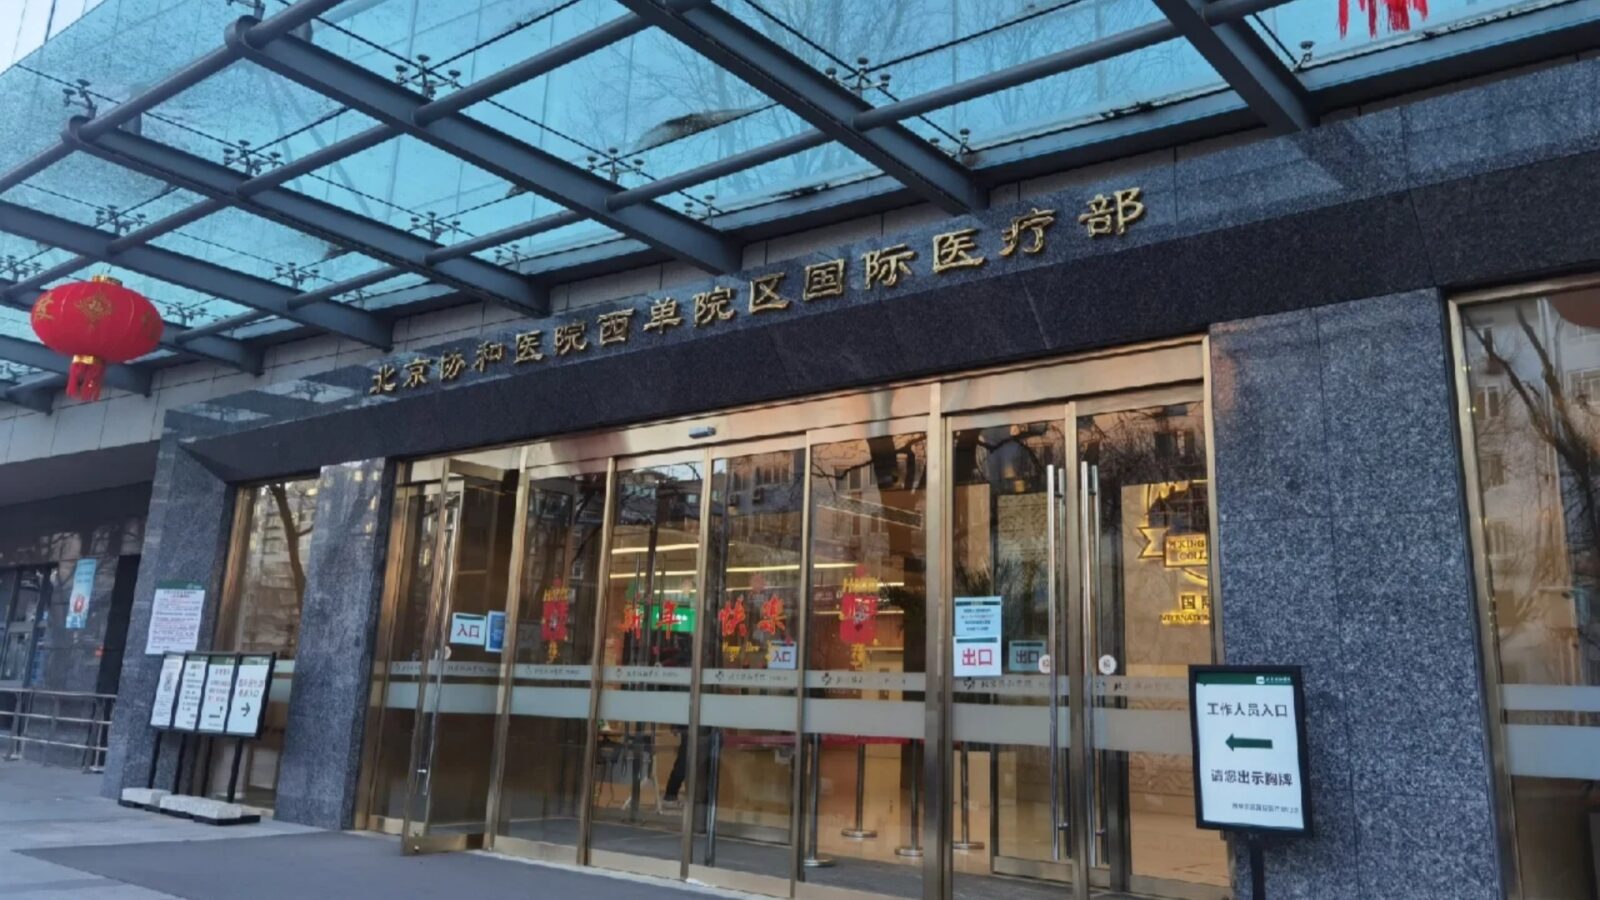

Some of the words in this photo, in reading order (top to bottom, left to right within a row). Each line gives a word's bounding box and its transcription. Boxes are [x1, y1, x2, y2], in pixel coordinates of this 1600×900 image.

[368, 186, 1148, 396] 北京协和医院西单院区国际医疗部
[456, 623, 481, 639] 入口
[961, 647, 994, 667] 出口
[1015, 648, 1040, 664] 出口
[1206, 702, 1289, 718] 工作人员入口
[1211, 768, 1294, 787] 请您出示胸牌
